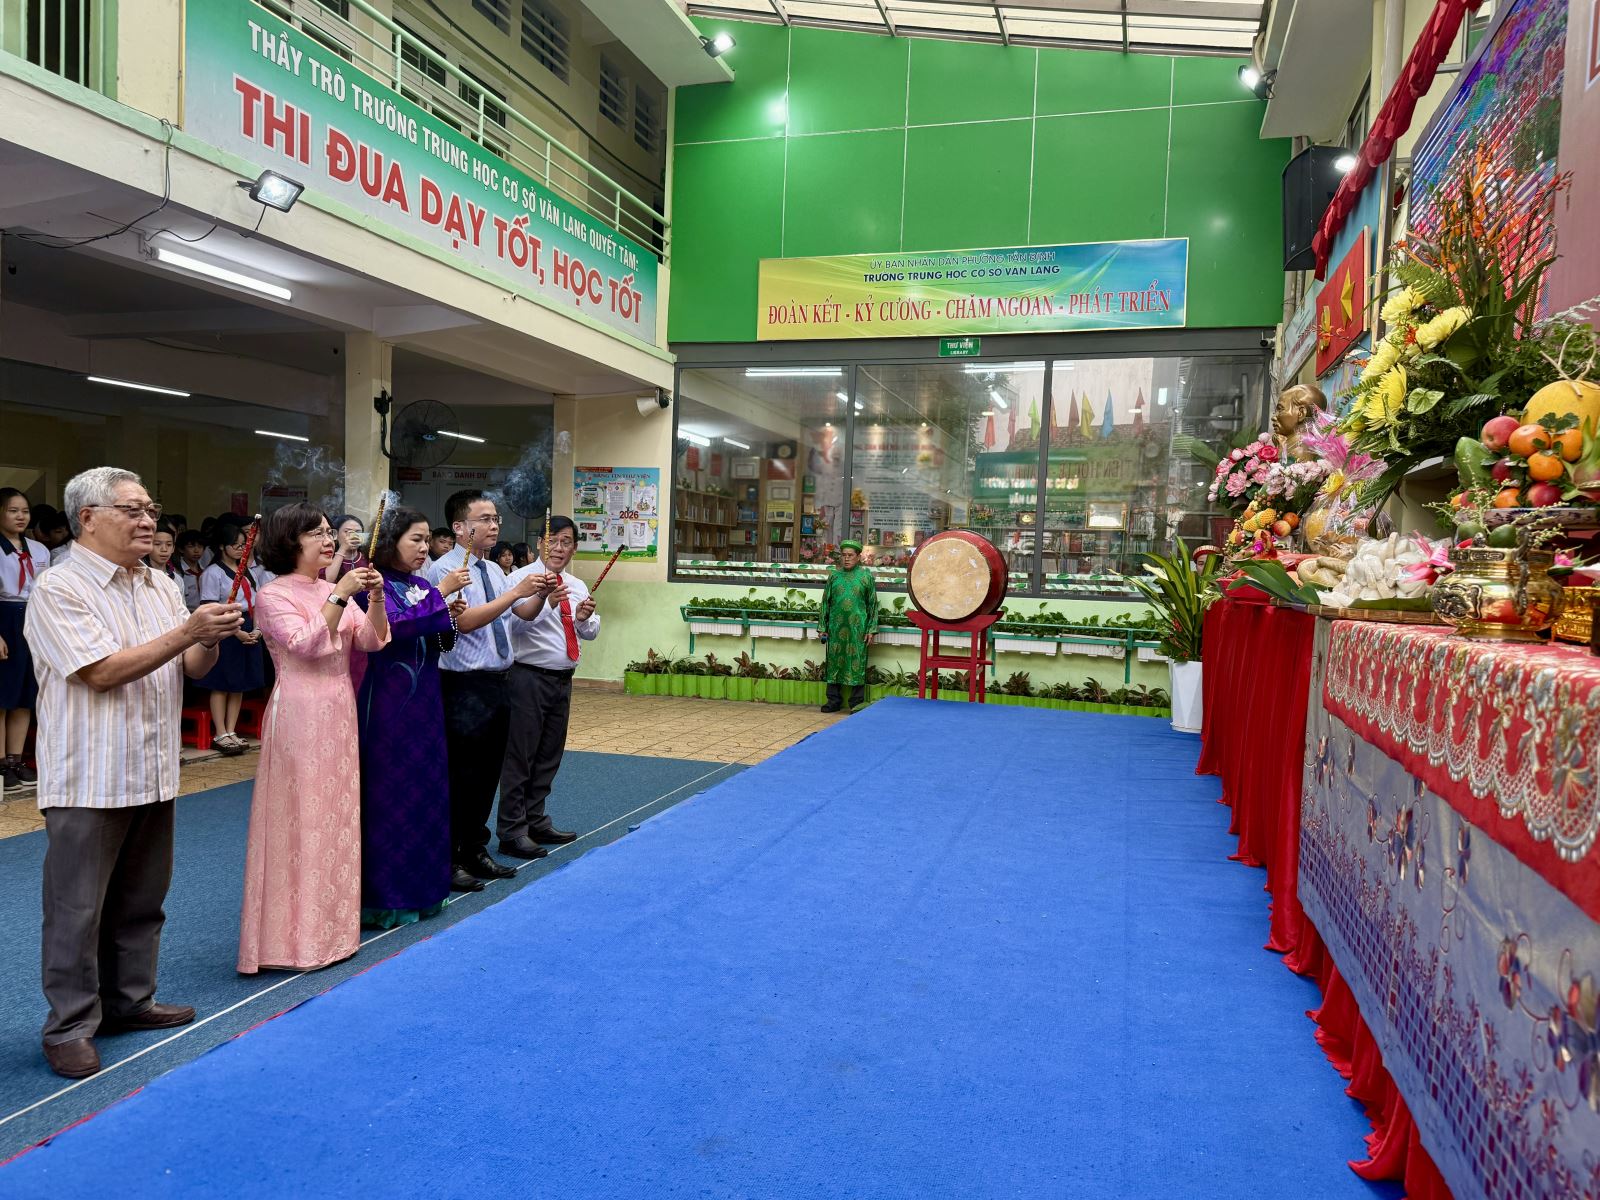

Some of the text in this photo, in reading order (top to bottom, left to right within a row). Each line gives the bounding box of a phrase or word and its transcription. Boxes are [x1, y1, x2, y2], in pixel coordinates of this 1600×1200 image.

[248, 20, 639, 272] THẦY TRÒ TRƯỜNG TRUNG HỌC CƠ SỞ VĂN LANG QUYẾT TÂM:
[234, 74, 643, 324] THI ĐUA DẠY TỐT, HỌC TỐT
[885, 260, 905, 269] BAN
[907, 256, 936, 268] NHÂN
[908, 271, 943, 281] TRUNG
[945, 269, 968, 280] HỌC
[1030, 264, 1060, 275] LANG
[768, 279, 1171, 325] ĐOÀN KẾT KỶ CƯƠNG CHĂM NGOAN PHÁT TRIỂN
[619, 510, 639, 519] 2026
